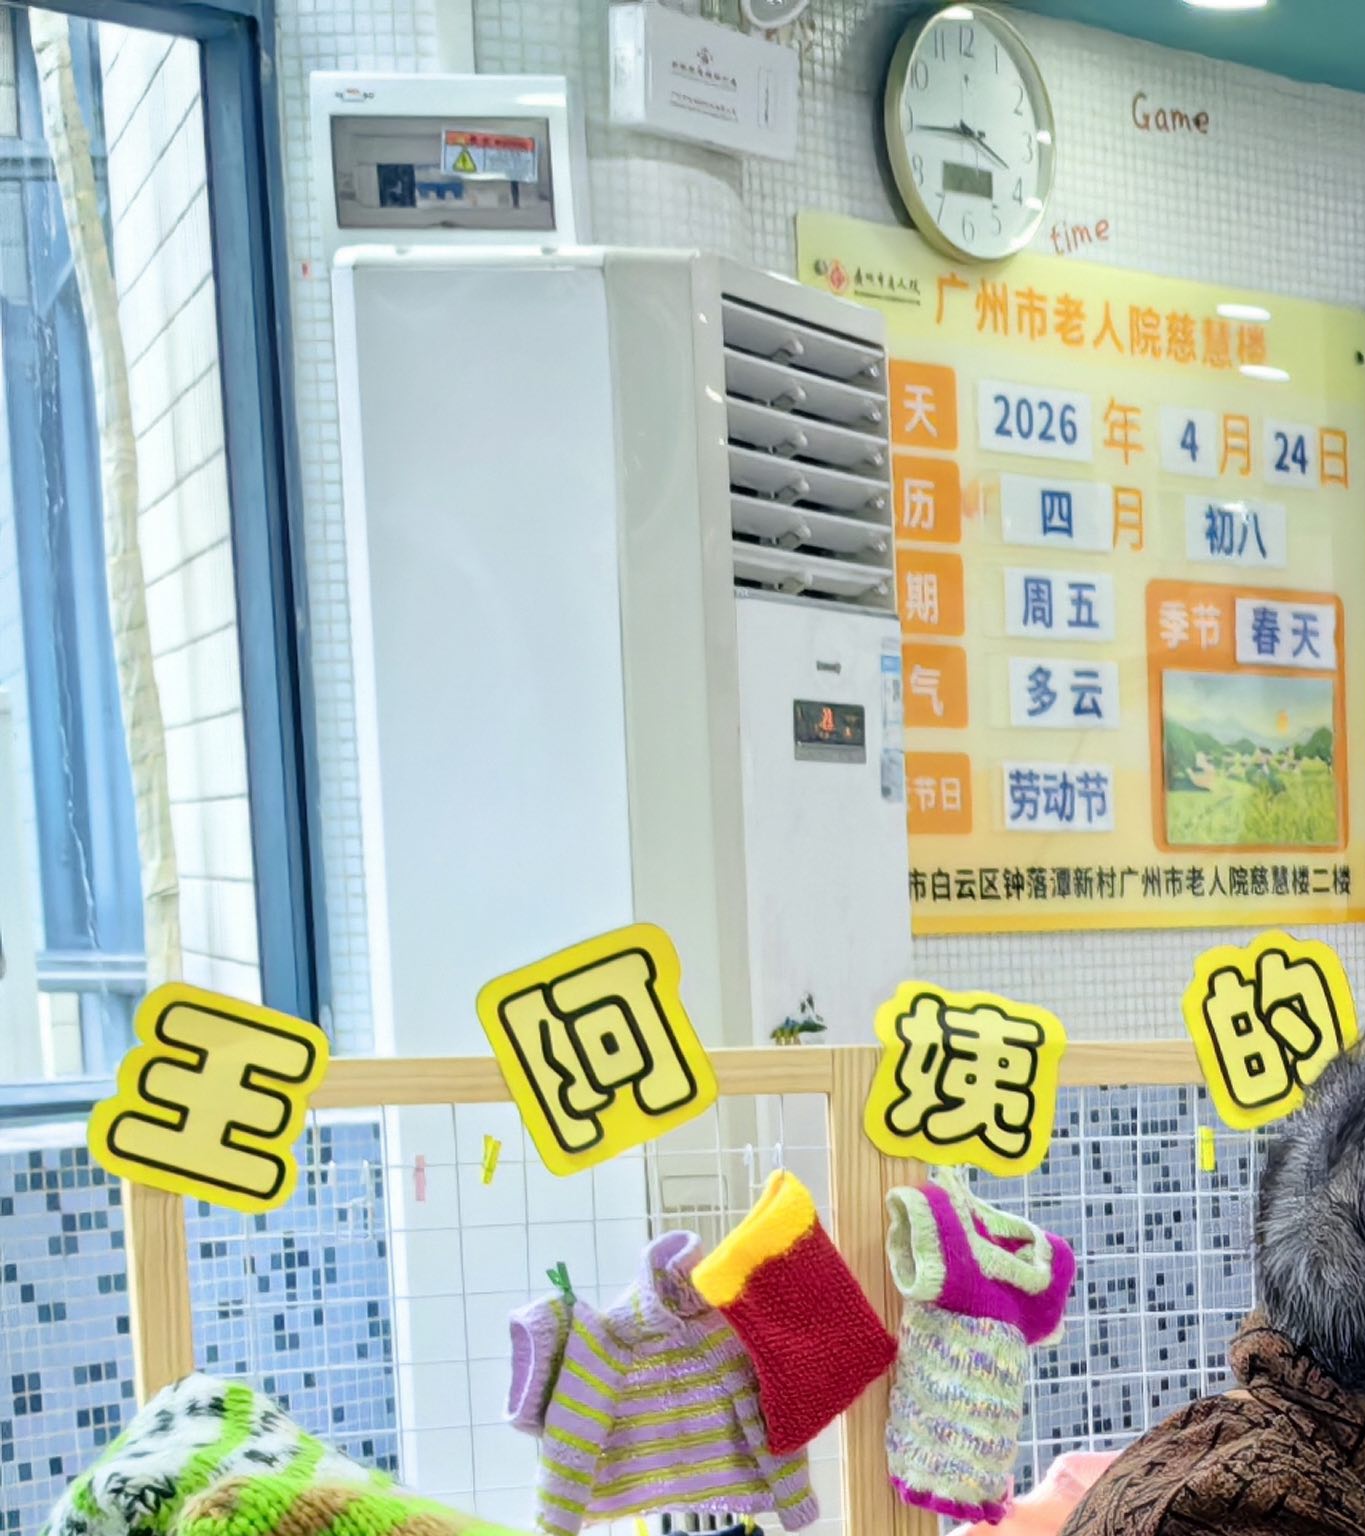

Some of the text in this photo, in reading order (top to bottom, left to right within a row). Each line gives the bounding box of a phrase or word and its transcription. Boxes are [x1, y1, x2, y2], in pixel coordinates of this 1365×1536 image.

[958, 26, 975, 58] 12
[1013, 86, 1024, 116] 2
[1131, 91, 1210, 135] Game
[1012, 177, 1023, 206] 4
[962, 212, 975, 242] 6
[1050, 219, 1110, 255] time
[935, 272, 1268, 370] 广州市老人院慈慧楼
[902, 384, 938, 438] 天
[993, 395, 1350, 488] 2026 年 4 月 24 日
[1041, 486, 1268, 560] 四 月 初八
[905, 571, 939, 625] 期
[1022, 577, 1100, 631] 周五
[1157, 602, 1321, 659] 季节 春天
[909, 663, 944, 716] 气
[1027, 665, 1103, 719] 多云
[905, 775, 962, 814] 节日
[1008, 771, 1109, 824] 劳动节
[106, 999, 316, 1199] 王
[495, 948, 702, 1155] 阿
[883, 992, 1045, 1160] 姨
[1203, 948, 1344, 1109] 的
